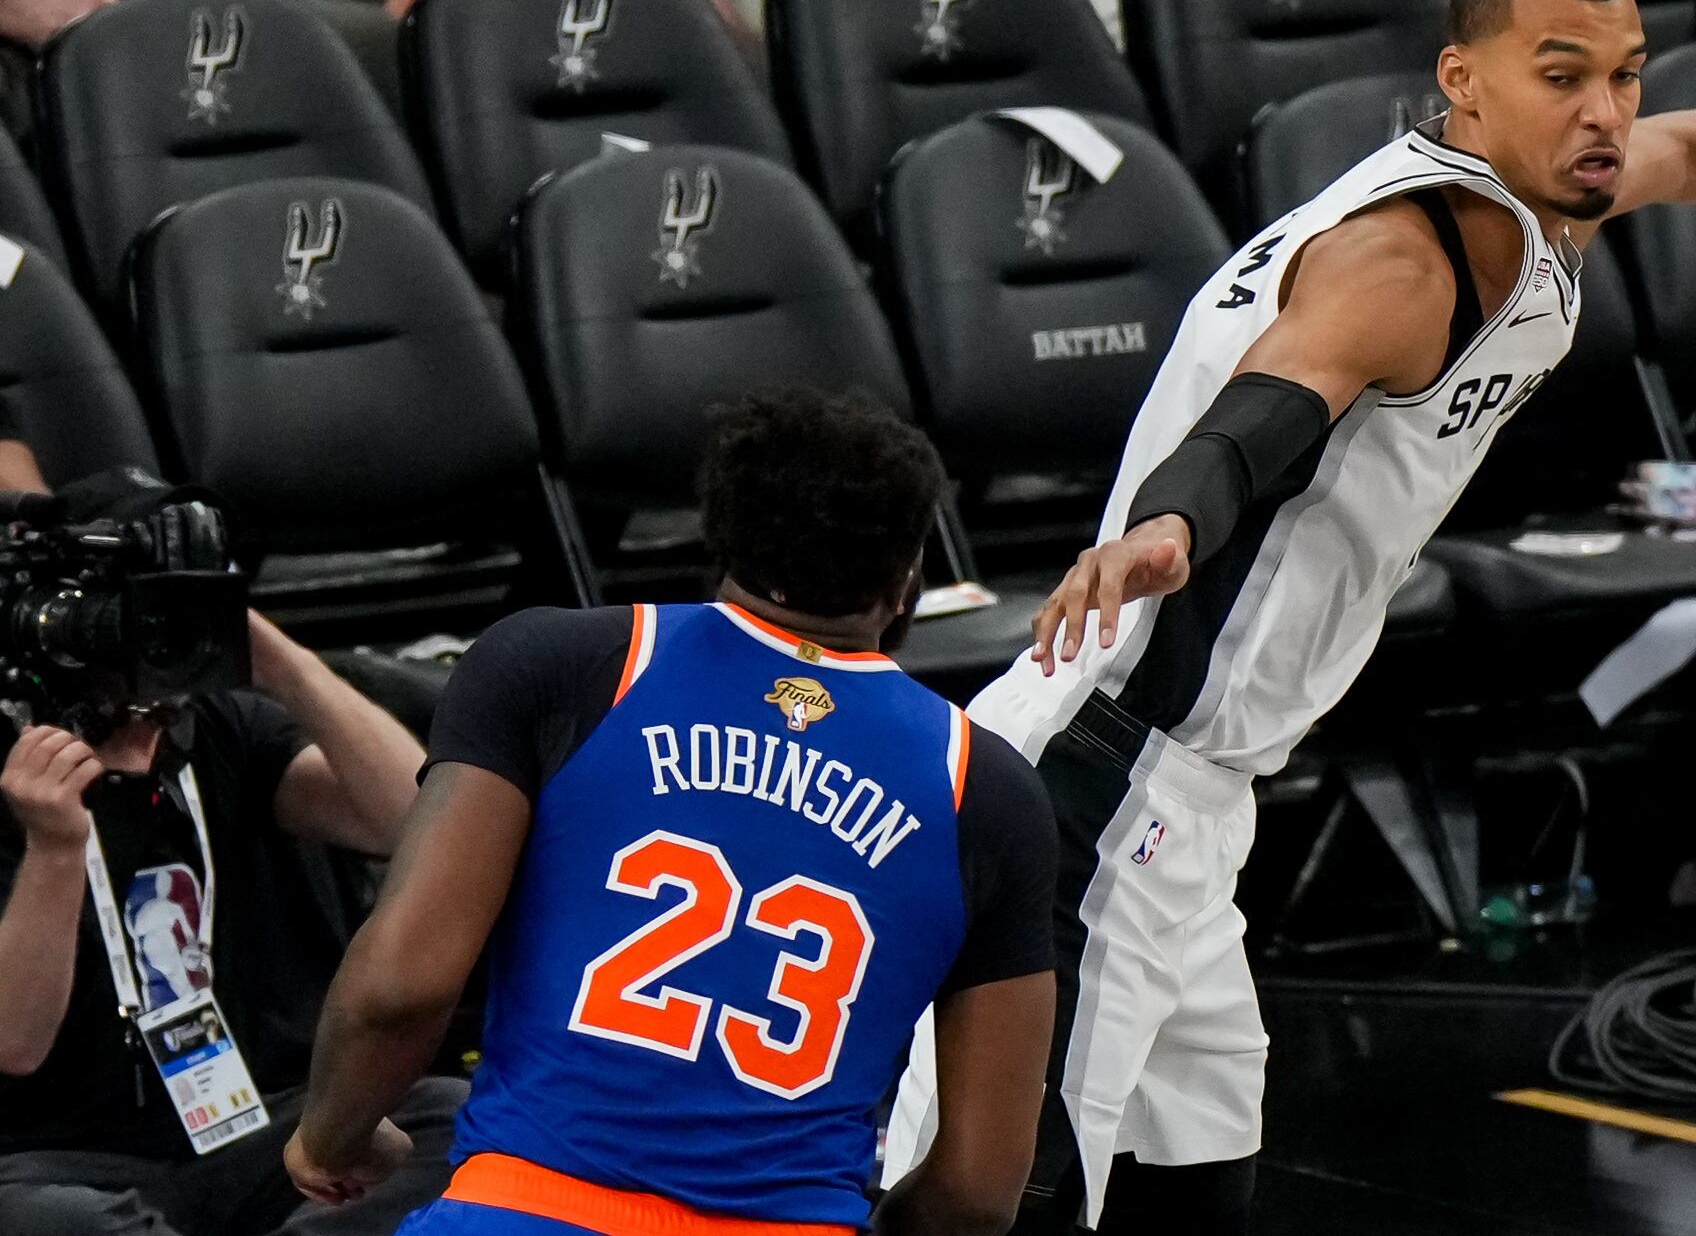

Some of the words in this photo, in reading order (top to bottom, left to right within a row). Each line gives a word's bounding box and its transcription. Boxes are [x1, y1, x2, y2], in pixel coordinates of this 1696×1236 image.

[774, 678, 833, 713] Finals
[641, 724, 921, 869] ROBINSON
[567, 829, 876, 1101] 23
